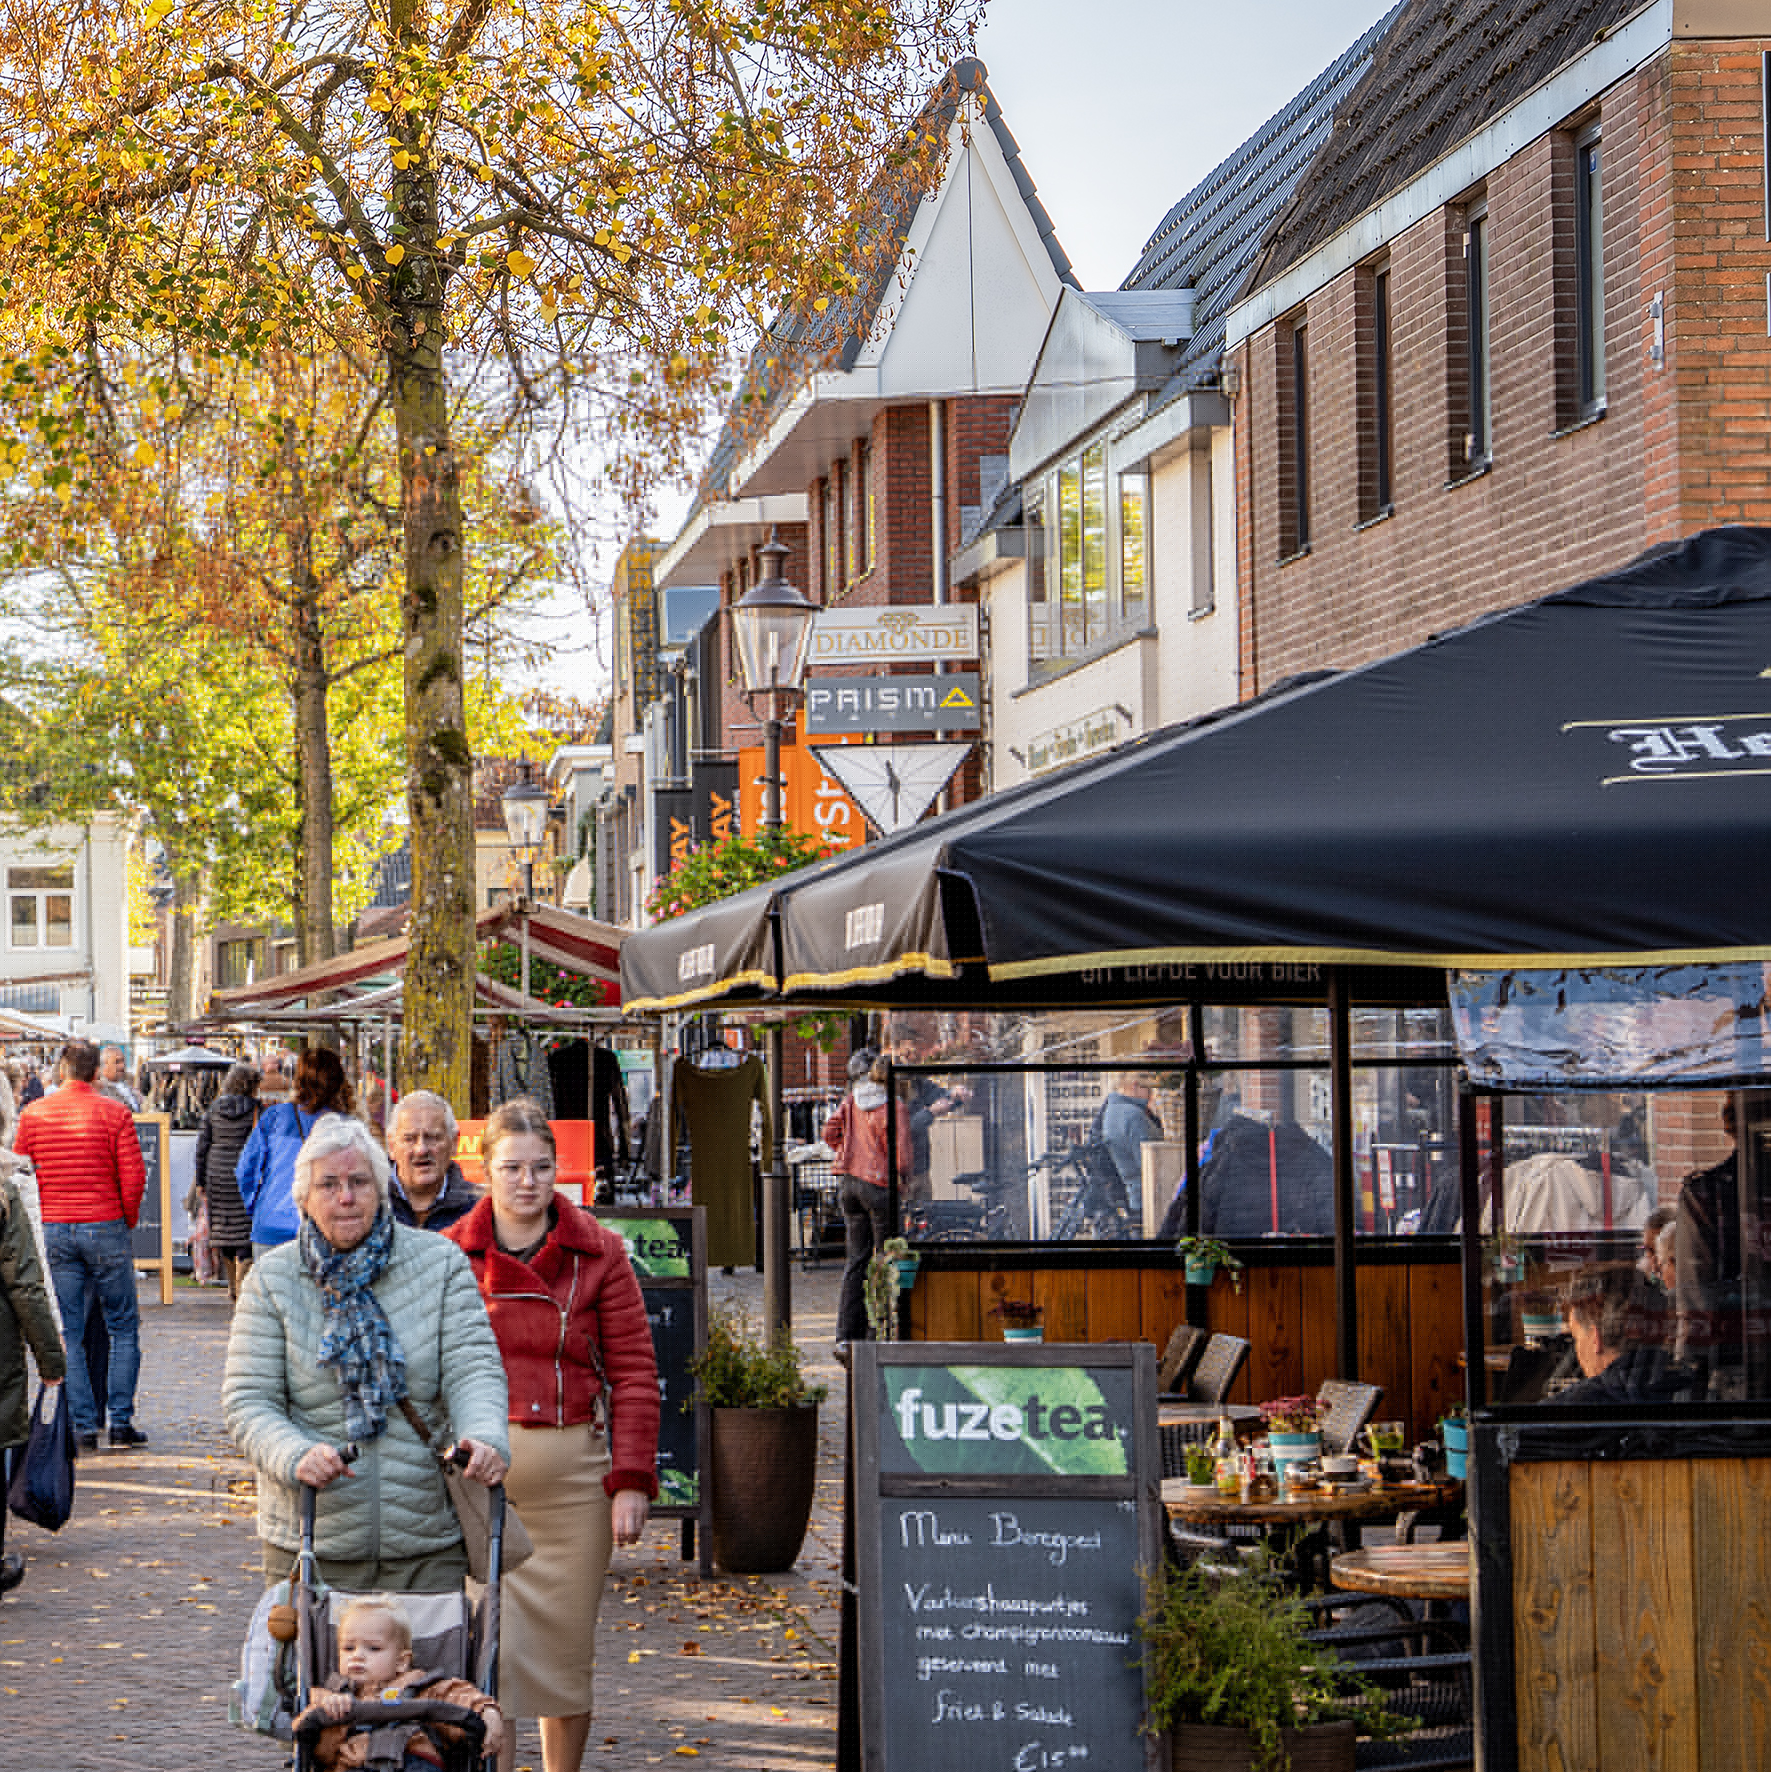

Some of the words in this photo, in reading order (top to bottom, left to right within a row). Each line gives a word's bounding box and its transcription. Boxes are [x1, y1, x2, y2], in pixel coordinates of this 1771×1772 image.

[815, 629, 970, 653] DIAMONDE
[811, 686, 974, 713] PRISMA
[895, 1388, 1117, 1441] fuzetea
[899, 1511, 973, 1549] Menu
